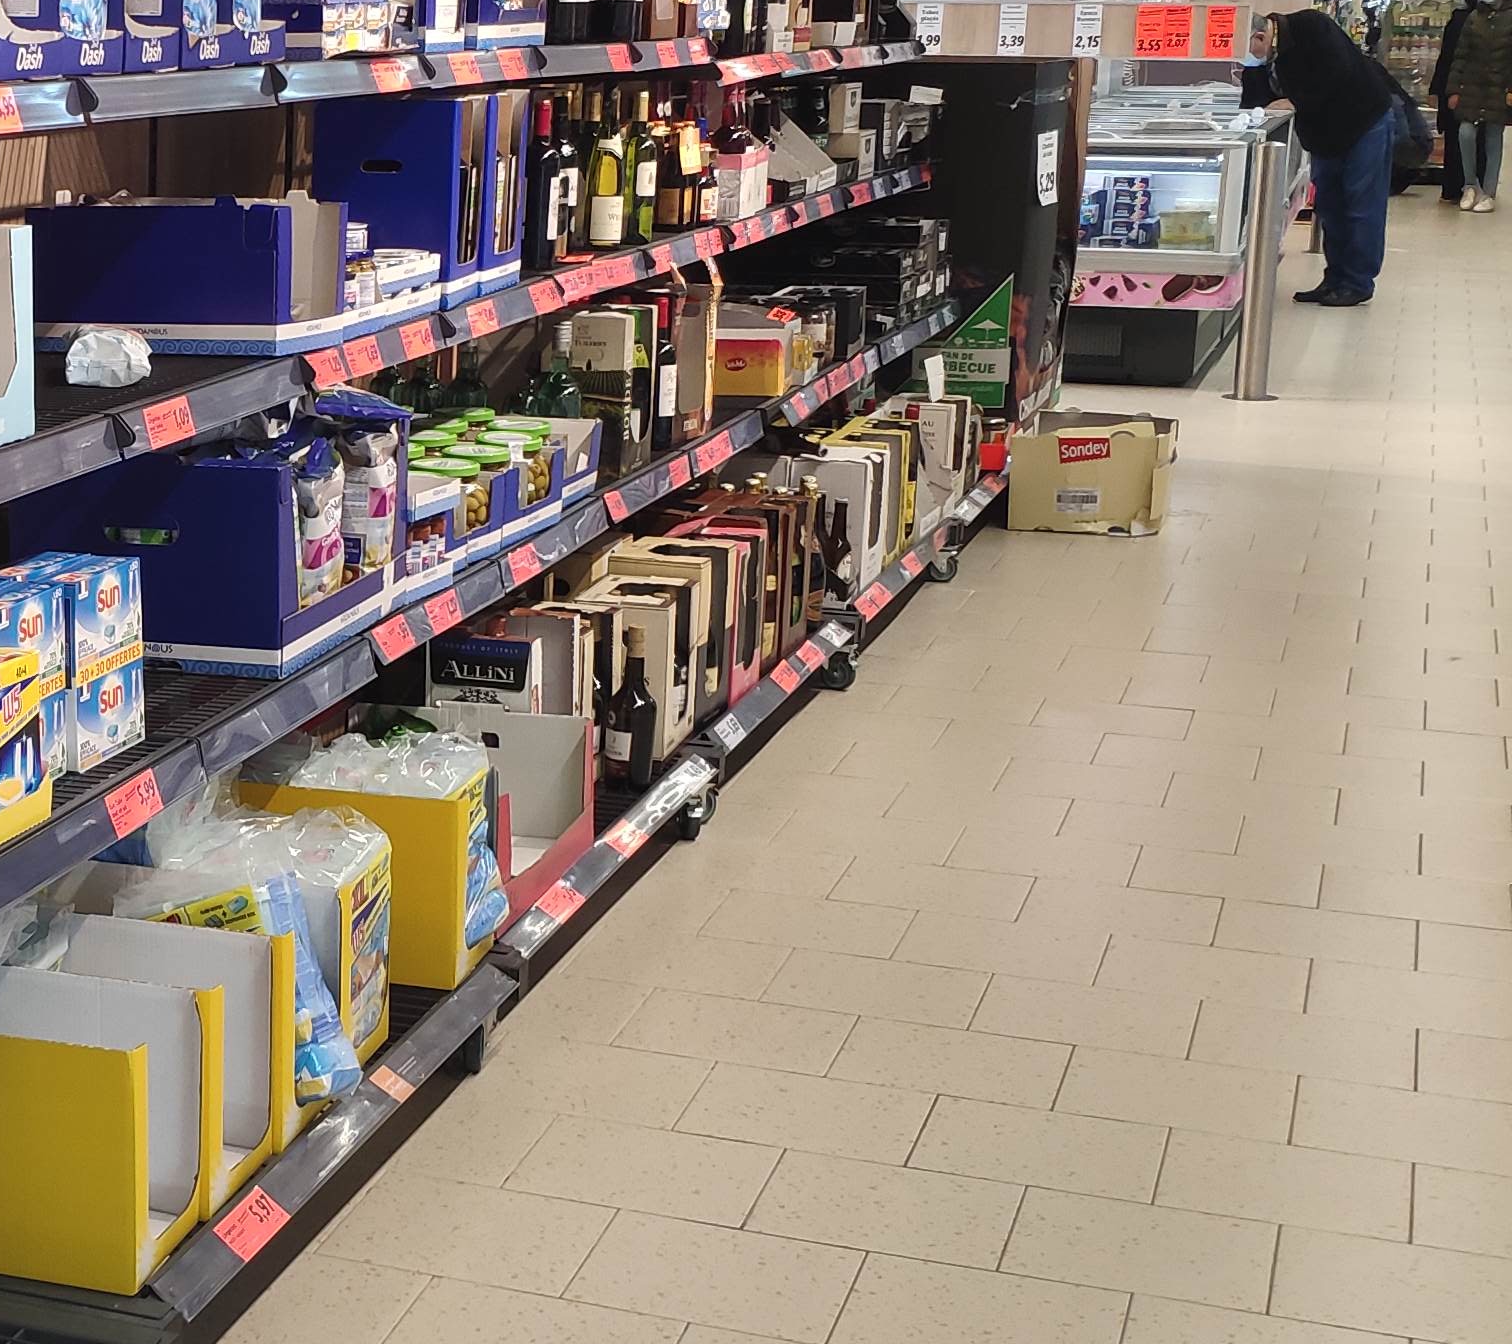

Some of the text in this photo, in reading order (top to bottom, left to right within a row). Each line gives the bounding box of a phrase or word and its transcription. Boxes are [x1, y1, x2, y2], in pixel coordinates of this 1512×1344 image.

[141, 40, 163, 64] Dash
[199, 40, 220, 62] Dash
[250, 34, 271, 57] Dash
[917, 33, 941, 48] 199
[999, 35, 1025, 49] 3,39
[1074, 35, 1101, 49] 2,15
[16, 47, 44, 71] Dash
[80, 44, 105, 67] Dash
[961, 352, 974, 361] DE
[1060, 439, 1109, 459] Sondey
[97, 584, 121, 614] Sun
[18, 612, 44, 644] Sun
[80, 642, 142, 684] 30 30 OFFERTES
[1, 682, 23, 726] W5
[100, 684, 124, 715] Sun
[135, 775, 156, 806] 5,99
[248, 1193, 276, 1224] 5,97
